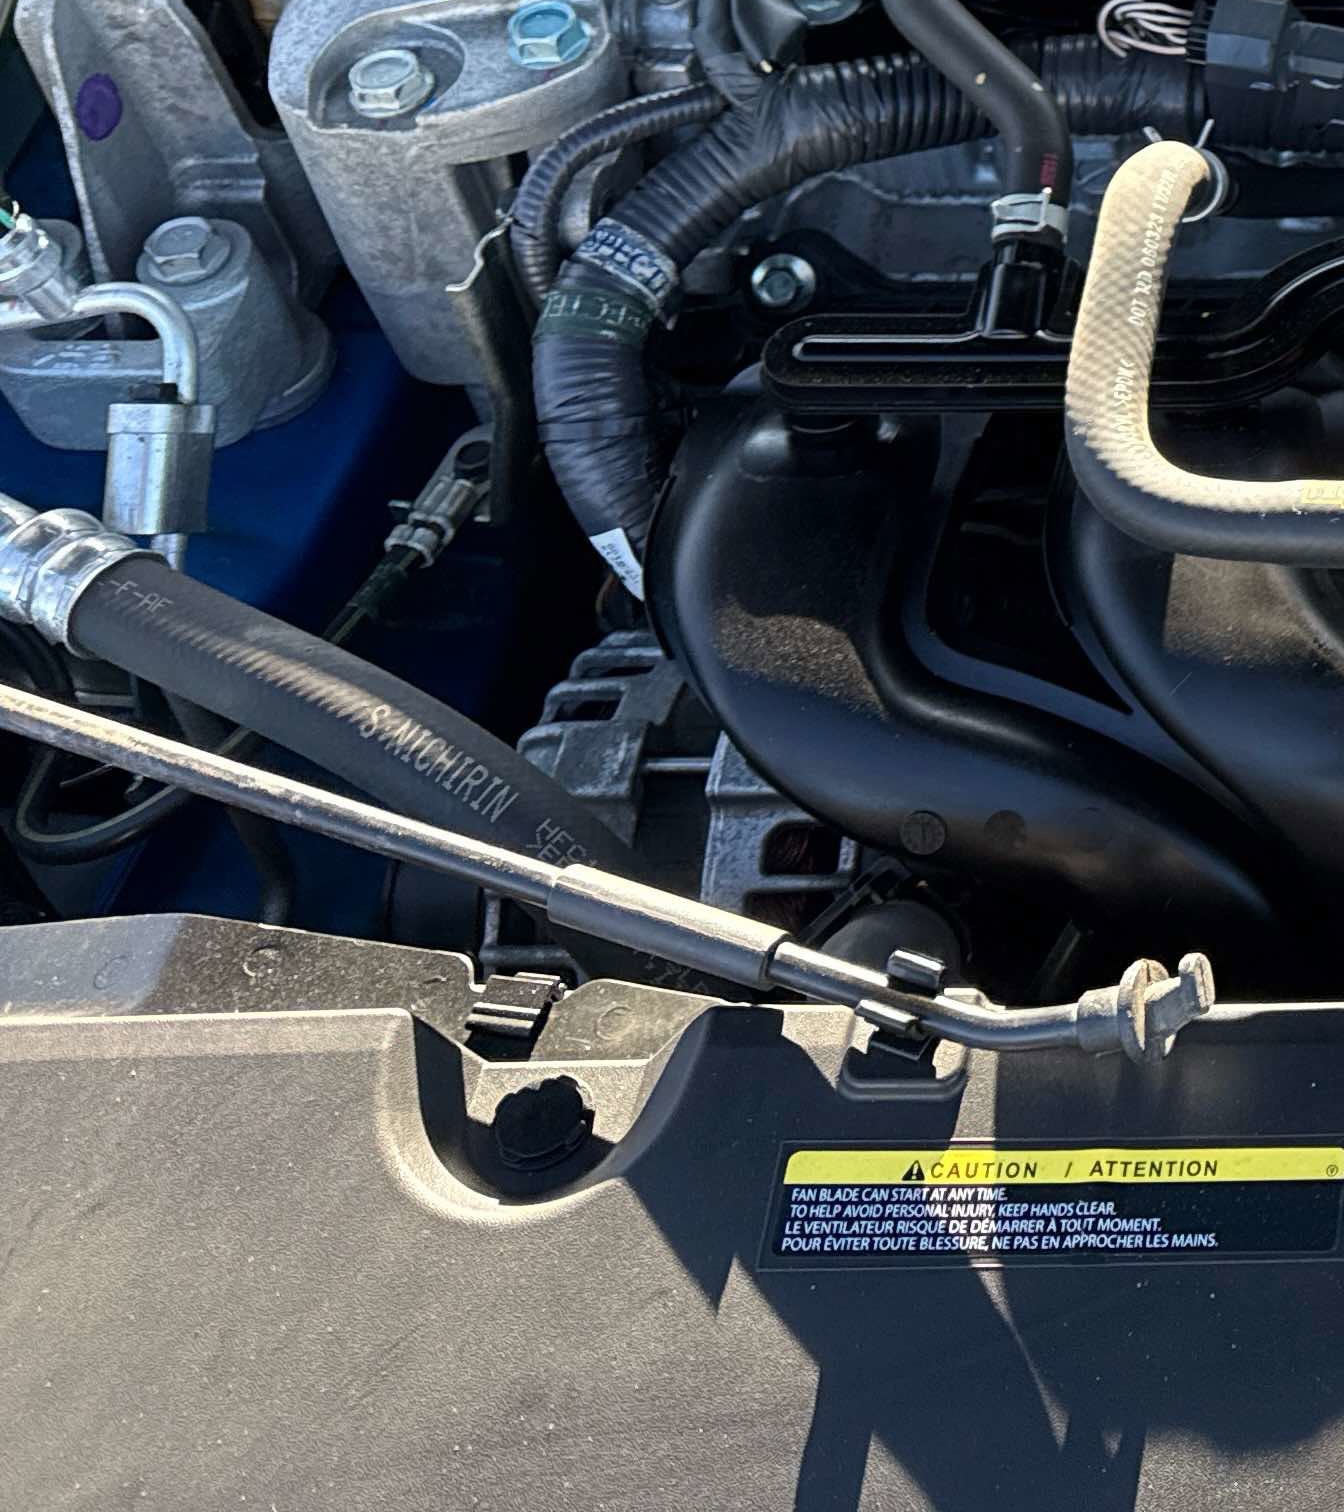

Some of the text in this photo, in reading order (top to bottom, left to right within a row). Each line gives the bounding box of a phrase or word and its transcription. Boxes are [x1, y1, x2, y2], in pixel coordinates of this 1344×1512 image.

[930, 1159, 1218, 1180] CAUTION / ATTENTION
[791, 1187, 1008, 1202] FAN BLADE CAN START AT ANY TIME.
[790, 1201, 1117, 1219] TO HELP AVOID PERSONAL INJURY, KEEP HANDS CLEAR.
[784, 1216, 1162, 1236] LE VENTILATEUR RISQUE DE DÉMARRER À TOUT MOMENT.
[781, 1233, 1219, 1252] POUR ÉVITER TOUTE BLESSURE, NE PAS EN APPROCHER LES MAINS.
